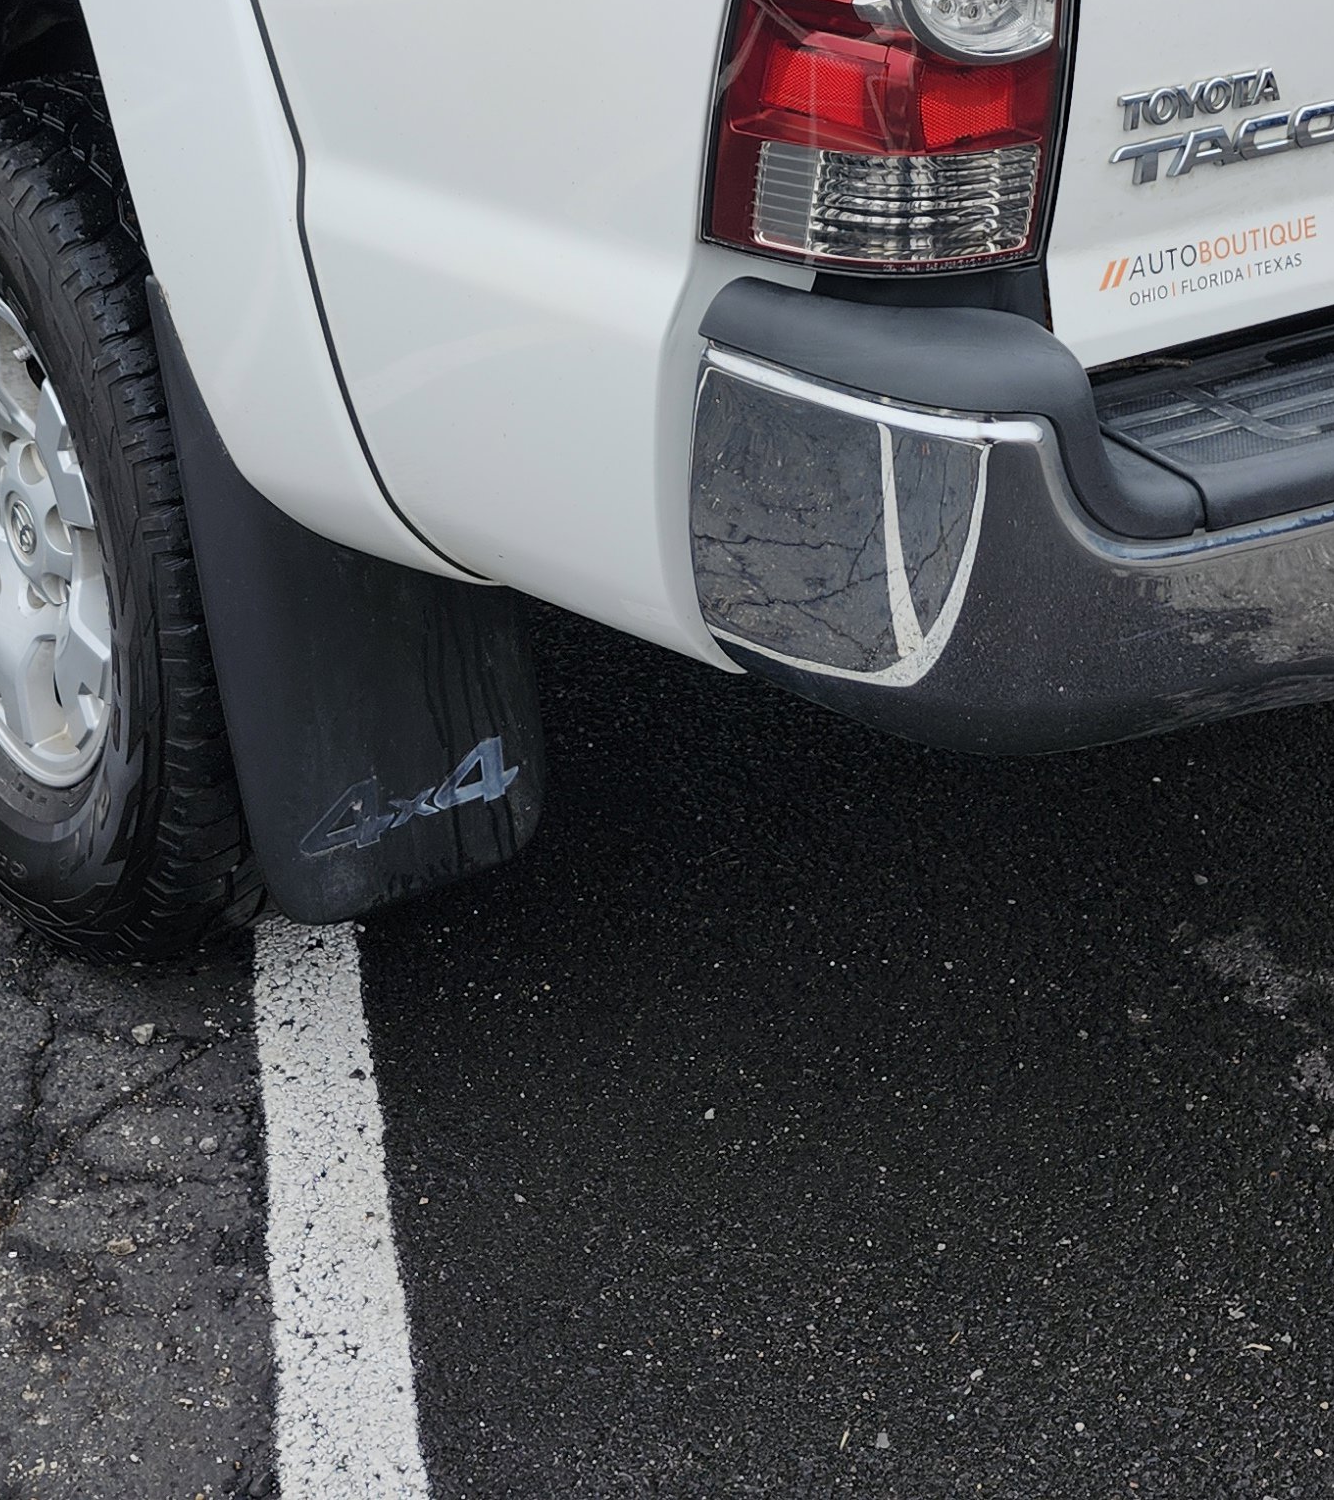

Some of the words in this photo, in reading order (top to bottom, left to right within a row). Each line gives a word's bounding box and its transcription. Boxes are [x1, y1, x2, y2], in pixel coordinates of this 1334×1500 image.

[1117, 67, 1281, 131] TOYOTA
[1129, 215, 1317, 281] AUTOBOUTIQUE
[1129, 283, 1168, 306] OHIO
[1181, 267, 1244, 295] FLORIDA
[1255, 252, 1303, 277] TEXAS
